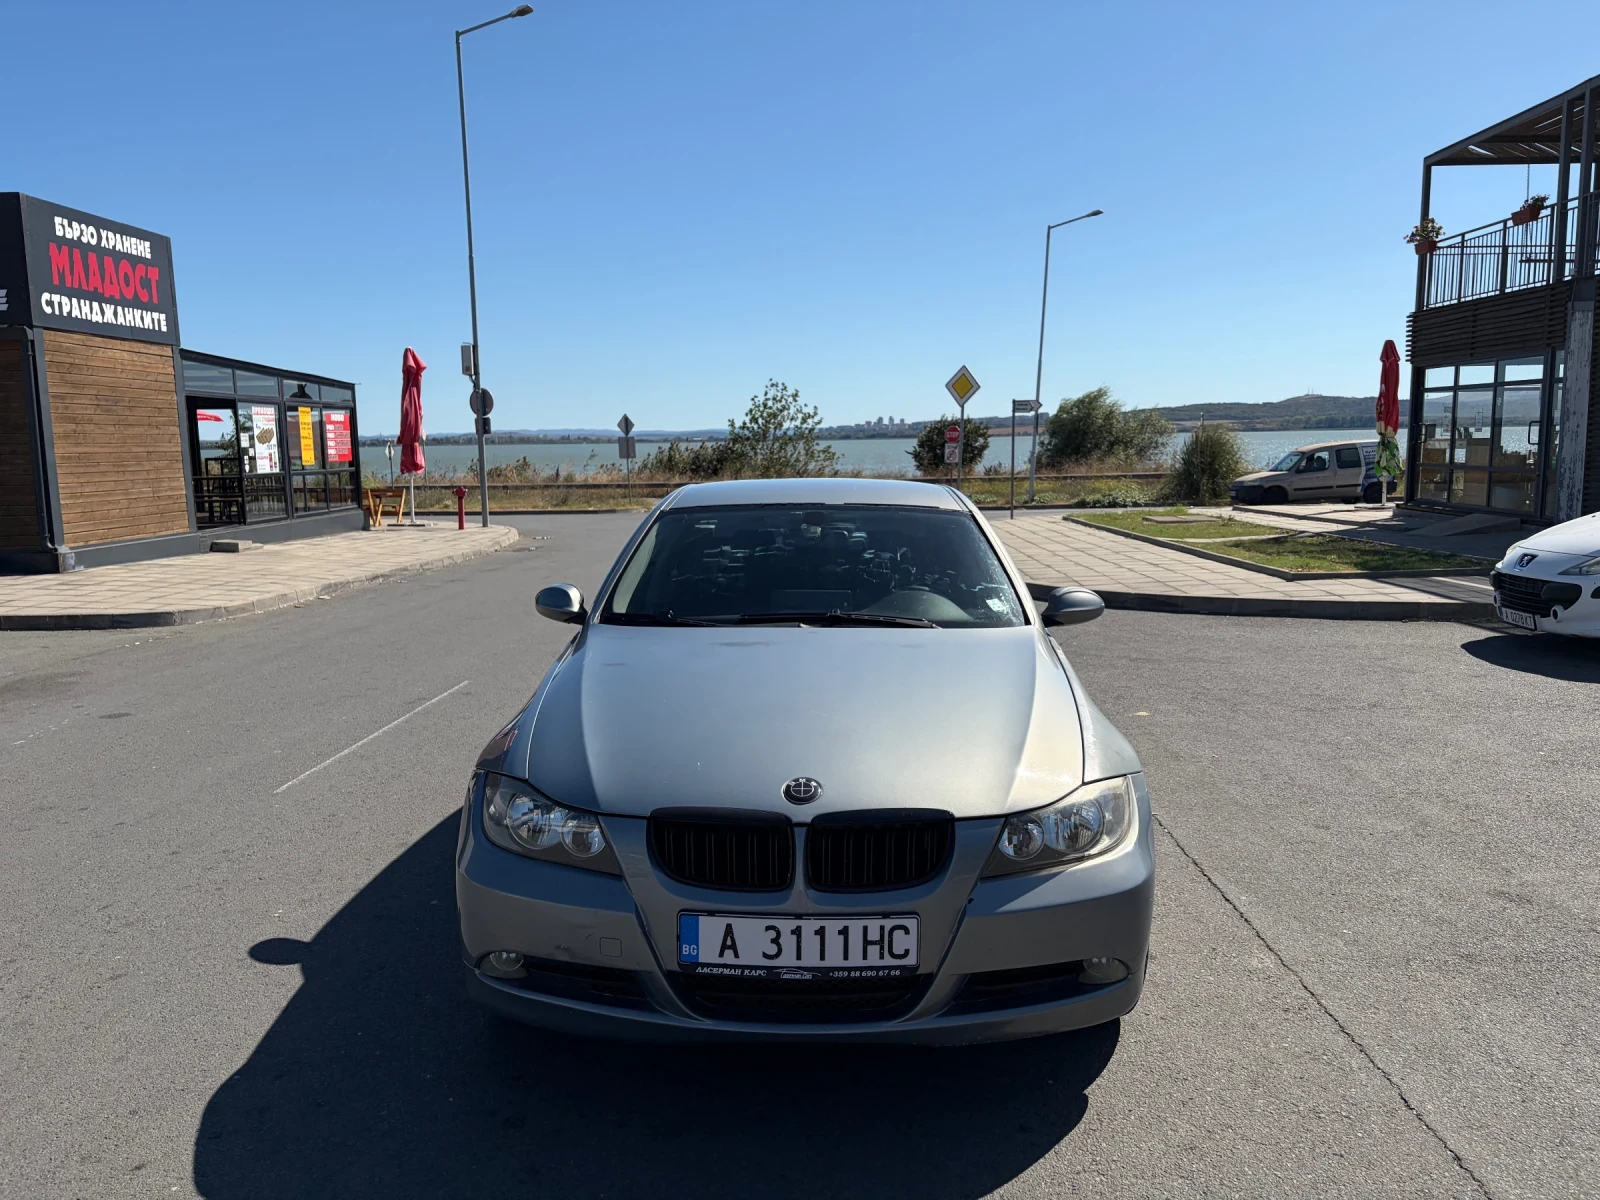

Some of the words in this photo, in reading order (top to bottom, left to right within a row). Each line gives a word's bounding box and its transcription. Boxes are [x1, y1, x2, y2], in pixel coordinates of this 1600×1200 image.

[53, 216, 98, 245] БЪРЗО
[99, 228, 152, 259] ХРАНЕНЕ
[48, 241, 160, 304] МЛАДОСТ
[40, 291, 168, 332] СТРАНДЖАНКИТЕ
[682, 944, 698, 956] BG
[718, 923, 740, 959] A
[762, 924, 911, 961] 3111HC
[695, 966, 742, 976] ЛАСЕРМАН
[743, 967, 767, 977] КАРС
[828, 970, 848, 978] +359
[850, 969, 861, 977] 88
[861, 969, 877, 977] 690
[878, 969, 889, 977] 67
[890, 968, 901, 976] 66
